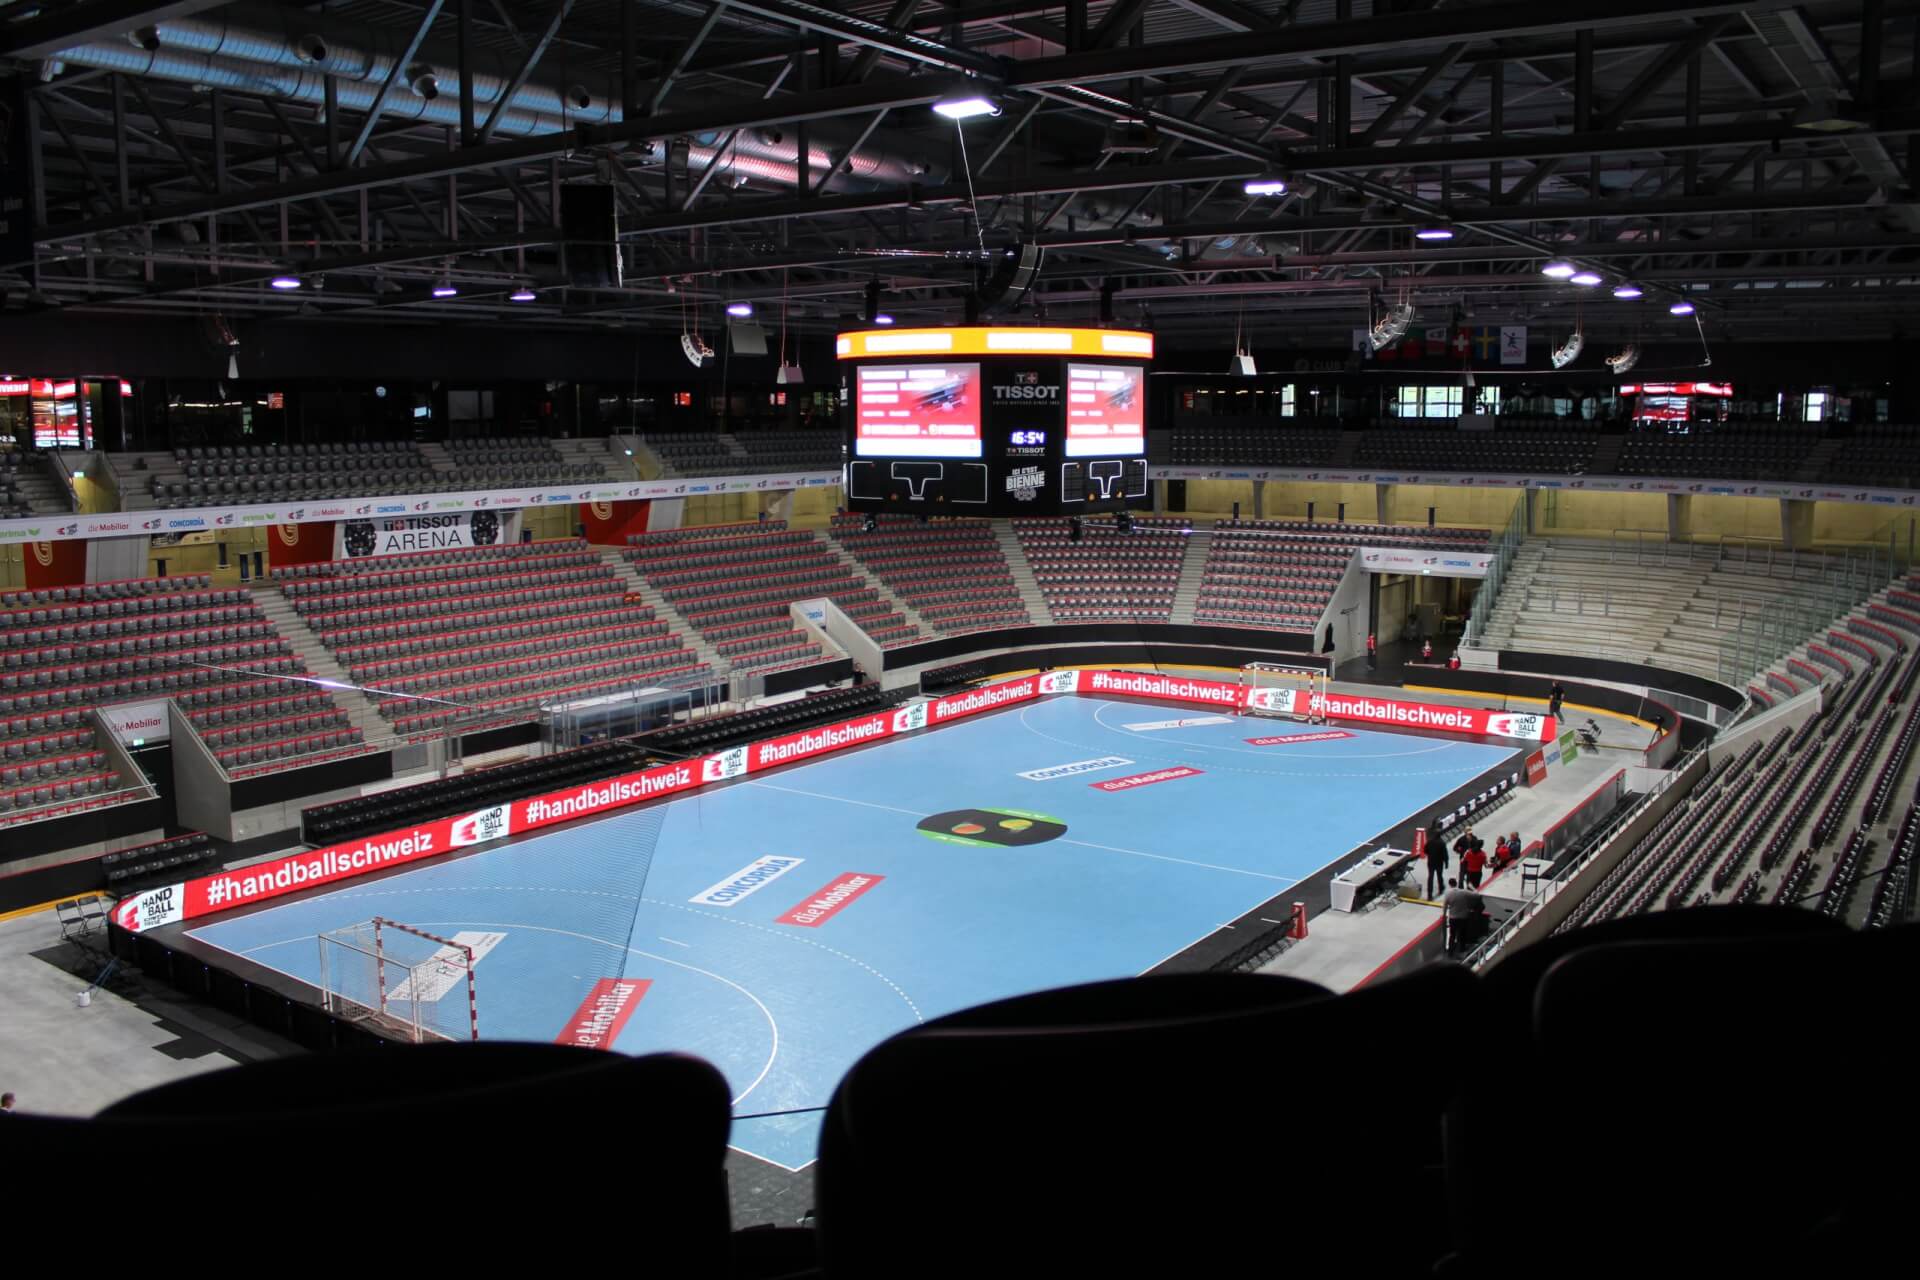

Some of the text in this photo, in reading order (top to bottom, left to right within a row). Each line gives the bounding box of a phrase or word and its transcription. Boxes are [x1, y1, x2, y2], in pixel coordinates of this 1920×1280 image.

[992, 385, 1060, 399] TISSOT
[1011, 431, 1045, 444] 16:54
[1006, 473, 1045, 490] BIENNE
[100, 522, 129, 531] Mobiliar
[169, 516, 206, 528] CONCORDIA
[405, 515, 462, 531] TISSOT
[385, 529, 463, 553] ARENA
[1091, 674, 1235, 702] #handballschweiz
[935, 681, 1033, 719] #handballschweiz
[1310, 694, 1473, 729] #handballschweiz
[125, 718, 161, 730] Mobiliar
[1514, 716, 1537, 726] HAND
[1518, 724, 1537, 733] BALL
[759, 718, 885, 764] #handballschweiz
[724, 749, 742, 763] HAND
[1030, 758, 1123, 779] CONCORDIA
[526, 767, 691, 824] #handballschweiz
[480, 808, 502, 825] HAND
[484, 818, 503, 831] BALL
[207, 831, 433, 906] #handballschweiz
[706, 859, 794, 903] CONCORDIA
[142, 887, 173, 910] HAND
[792, 876, 872, 924] die Mobiliar
[148, 900, 175, 917] BALL
[576, 982, 637, 1035] Mobiliar
